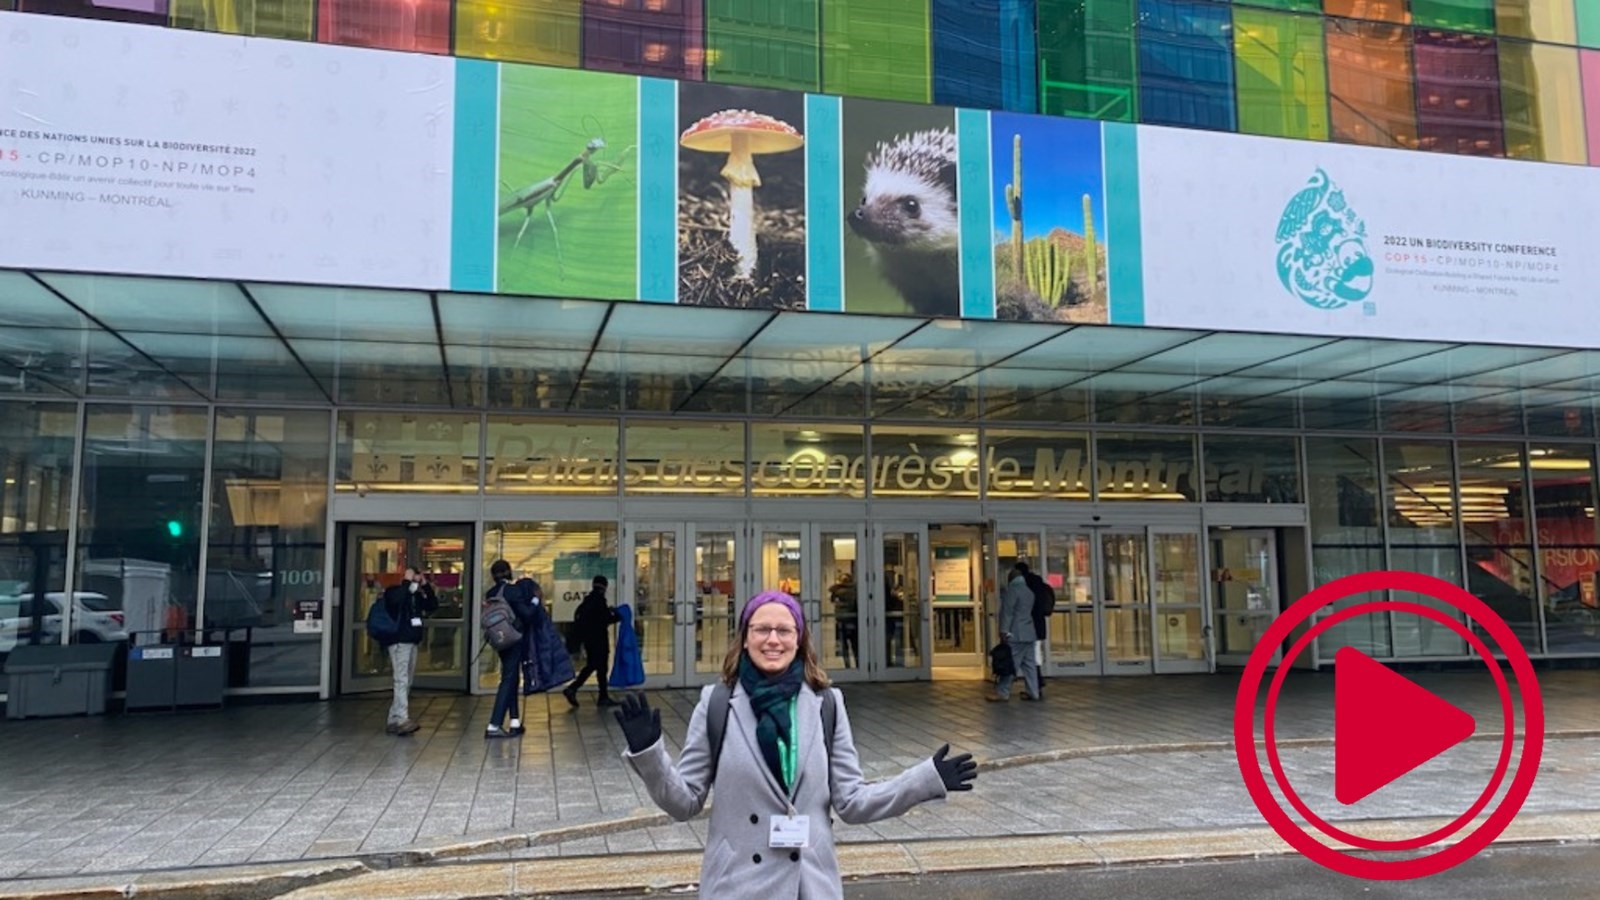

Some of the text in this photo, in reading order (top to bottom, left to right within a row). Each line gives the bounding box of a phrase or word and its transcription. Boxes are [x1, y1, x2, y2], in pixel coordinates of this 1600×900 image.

[20, 129, 40, 139] DES
[43, 132, 88, 143] NATIONS
[91, 136, 121, 146] UNIES
[124, 138, 144, 147] SUR
[147, 139, 160, 148] LA
[233, 147, 256, 156] 2022
[21, 188, 86, 202] KUNMING
[100, 193, 173, 208] MONTRÉAL
[1384, 235, 1557, 257] 2022 UN BIODIVERSITY CONFERENCE
[1385, 252, 1410, 263] COP
[488, 435, 1264, 498] Palais des congrès de Montréal
[280, 570, 322, 585] 1001
